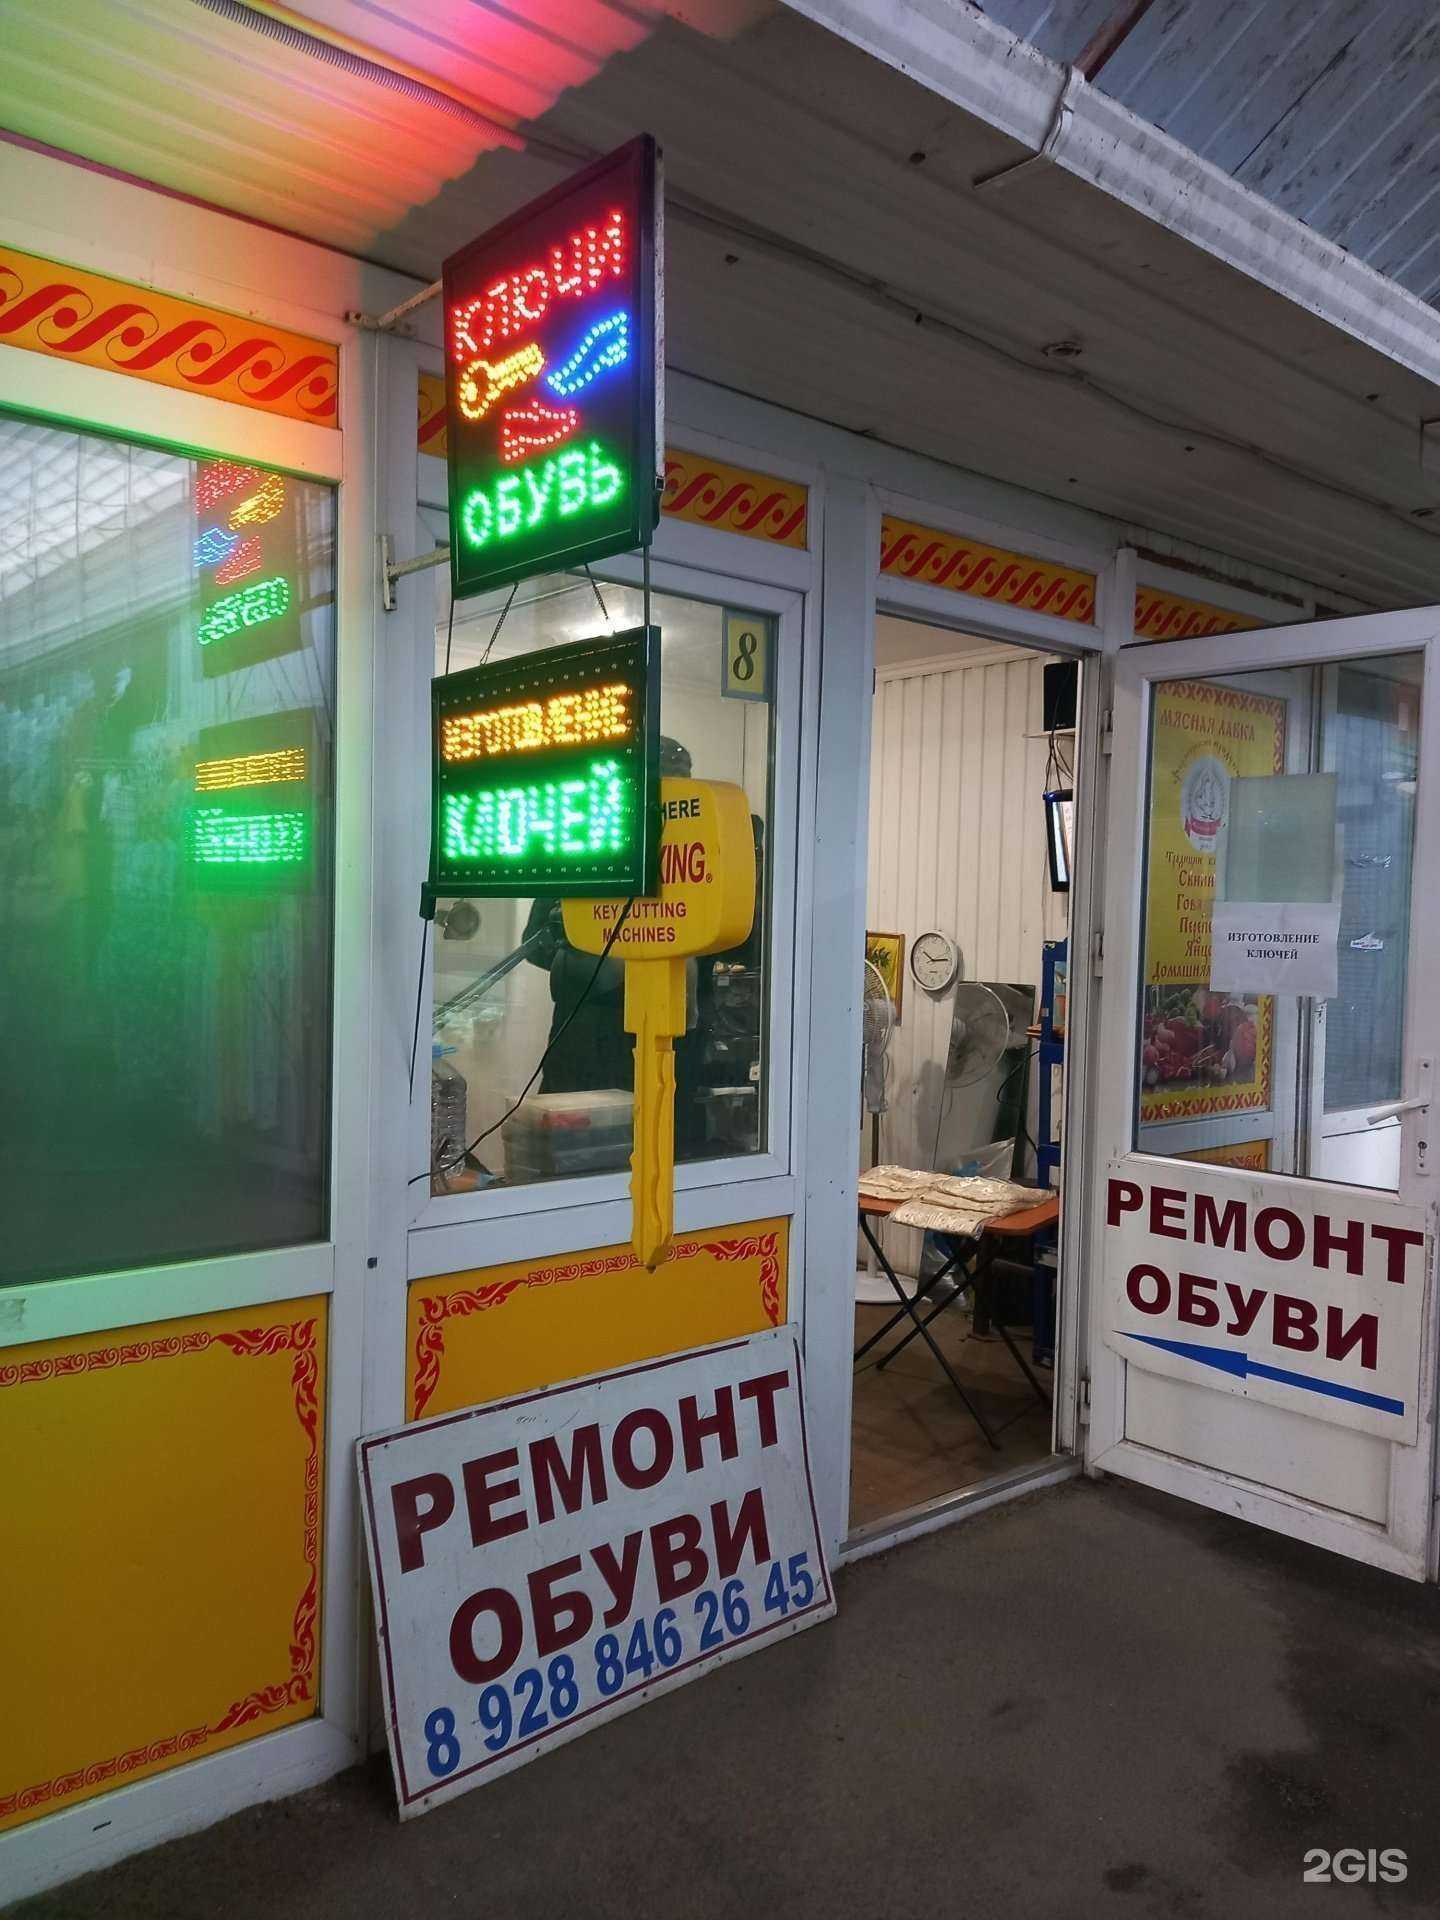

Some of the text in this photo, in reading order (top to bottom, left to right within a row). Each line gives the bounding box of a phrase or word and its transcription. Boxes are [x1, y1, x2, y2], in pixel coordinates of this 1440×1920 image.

[463, 442, 622, 548] ОБУВЬ
[733, 632, 757, 680] 8
[593, 904, 619, 920] KEY
[1228, 932, 1320, 944] ИЗГОТОВЛЕНИЕ
[1247, 948, 1298, 960] КЛЮЧЕЙ
[1107, 1178, 1424, 1284] РЕМОНТ
[1126, 1264, 1379, 1370] ОБУВИ
[390, 1370, 789, 1574] РЕМОНТ
[449, 1487, 772, 1684] ОБУВИ
[424, 1552, 815, 1777] 8 928 846 26 45
